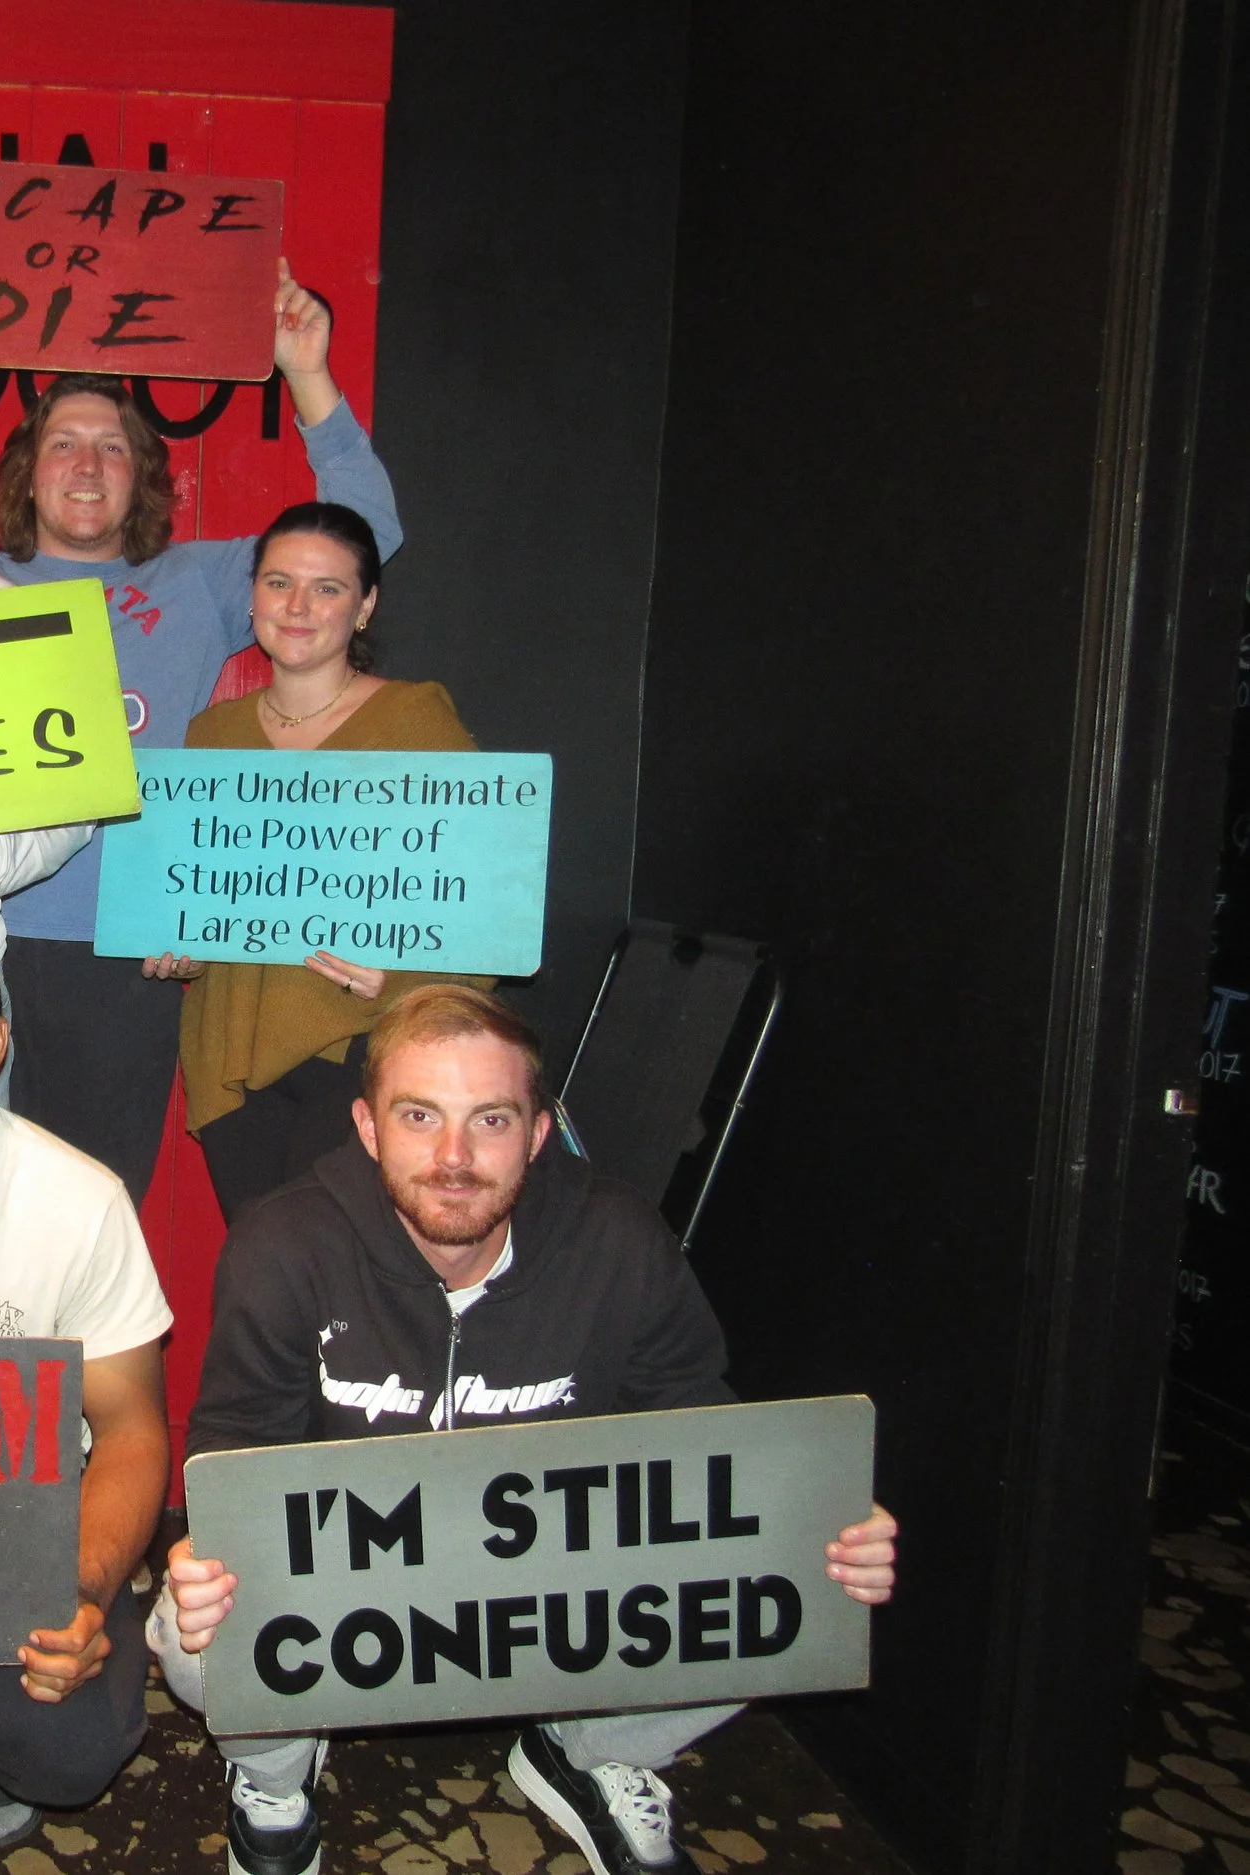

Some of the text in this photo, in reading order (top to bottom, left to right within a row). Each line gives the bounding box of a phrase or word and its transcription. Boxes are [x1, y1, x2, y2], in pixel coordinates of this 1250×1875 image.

[26, 242, 99, 277] OR
[136, 770, 537, 807] ever Underestimate
[191, 815, 449, 853] the Power of
[165, 863, 466, 909] Stupid People in
[177, 910, 444, 959] Large Groups
[284, 1453, 760, 1576] I'M STILL
[253, 1572, 803, 1696] CONFUSED
